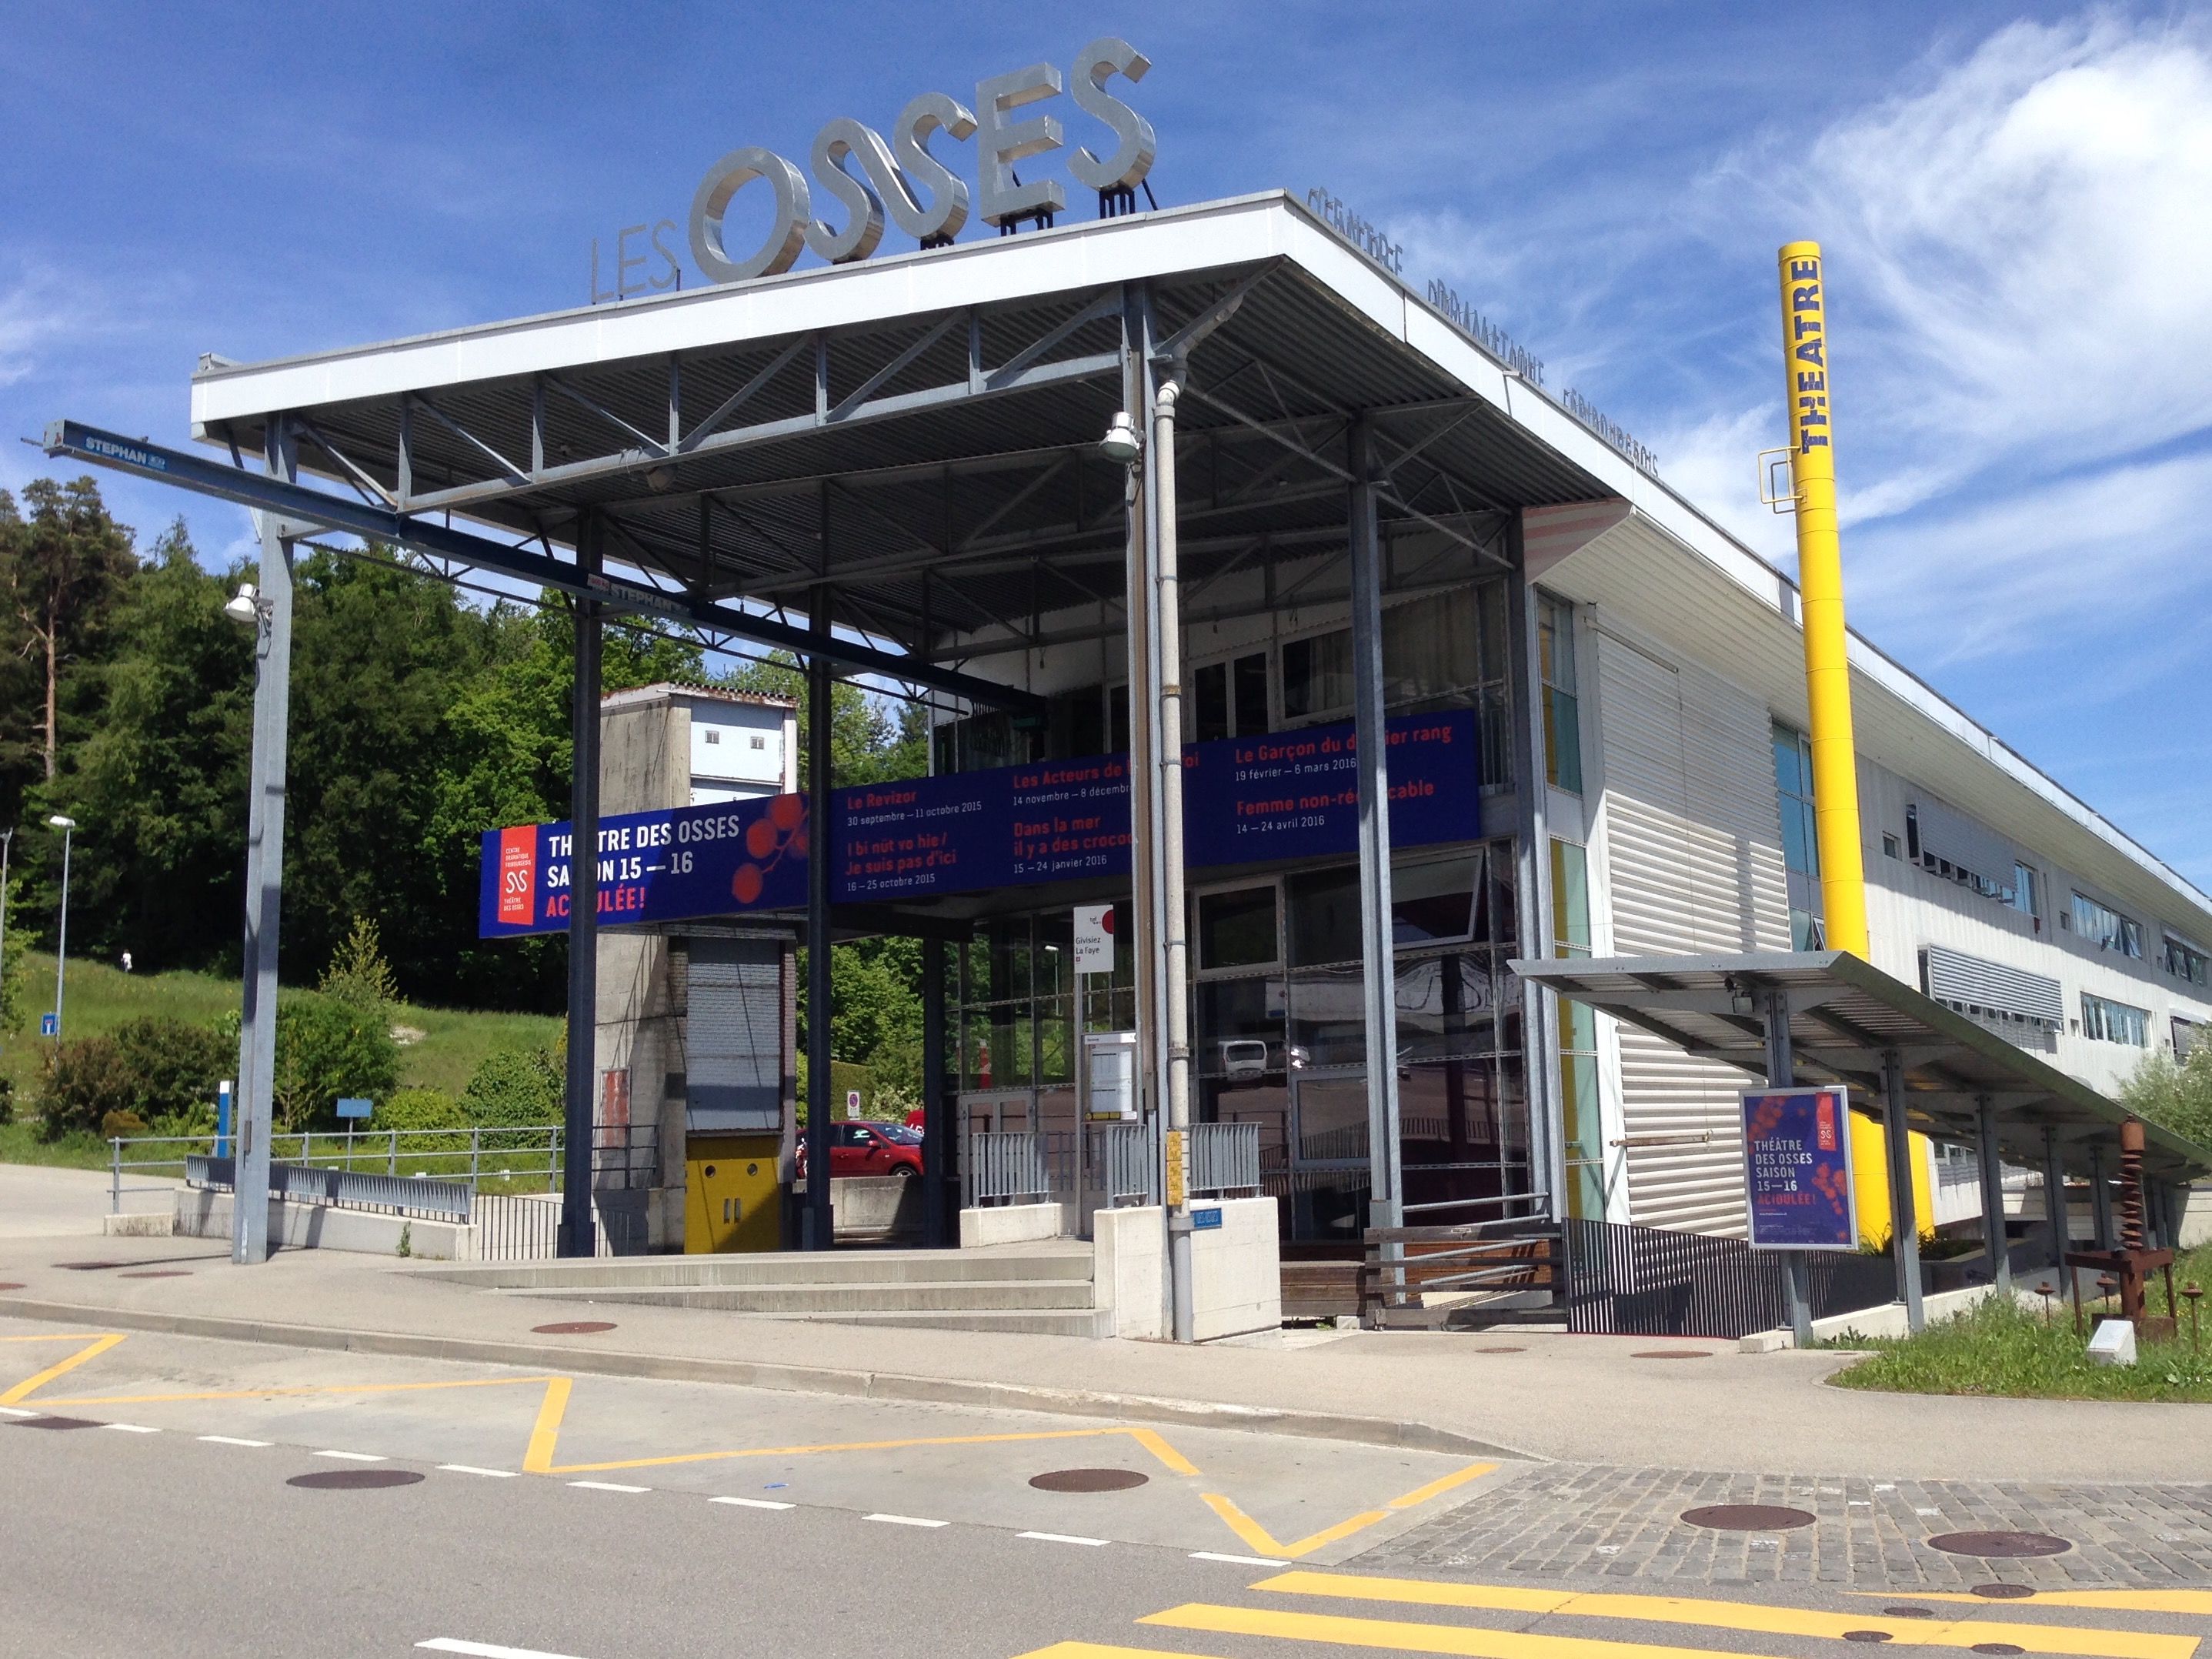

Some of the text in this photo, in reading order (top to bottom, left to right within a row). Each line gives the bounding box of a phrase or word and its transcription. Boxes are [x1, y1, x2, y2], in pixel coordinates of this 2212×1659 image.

[591, 37, 1156, 304] LES OSSES
[1790, 260, 1829, 455] THEATRE
[85, 436, 147, 465] STEPHAN
[610, 583, 672, 612] STEPHAN
[1235, 726, 1453, 763] Le Garçon du dier rang
[1013, 775, 1038, 789] Les
[1043, 767, 1099, 785] Acteurs
[1104, 761, 1123, 777] de
[1235, 771, 1246, 781] 19
[1249, 768, 1282, 780] février
[1304, 763, 1330, 774] mars
[1333, 757, 1356, 770] 2016
[847, 790, 917, 809] Le Revizor
[1013, 796, 1023, 806] 14
[1026, 791, 1069, 804] novembre
[1236, 796, 1294, 816] Femme
[847, 816, 858, 826] 30
[861, 812, 905, 826] septembre
[916, 808, 923, 819] 11
[926, 804, 959, 816] octobre
[962, 800, 982, 813] 2015
[1014, 816, 1101, 838] Dans la mer
[1236, 824, 1248, 834] 14
[1261, 821, 1273, 832] 24
[1276, 817, 1298, 830] avril
[1301, 815, 1325, 828] 2016
[549, 815, 739, 858] THTRE DES OSSES
[856, 840, 868, 856] bi
[1014, 840, 1023, 856] il
[1026, 843, 1035, 860] y
[1039, 842, 1048, 854] a
[1052, 836, 1079, 853] des
[547, 860, 614, 888] SAN
[619, 856, 641, 880] 15
[671, 851, 693, 874] 16
[846, 861, 862, 876] Je
[865, 856, 894, 874] suis
[897, 856, 923, 874] pas
[1013, 863, 1024, 873] 15
[1036, 861, 1048, 872] 24
[1051, 858, 1083, 872] janvier
[1086, 855, 1107, 866] 2016
[847, 882, 856, 892] 16
[867, 880, 877, 890] 25
[879, 876, 912, 889] octobre
[915, 873, 936, 884] 2015
[1754, 1137, 1803, 1151] THÉÂTRE
[1755, 1153, 1813, 1165] DES OSSES
[1756, 1167, 1796, 1178] SAISON
